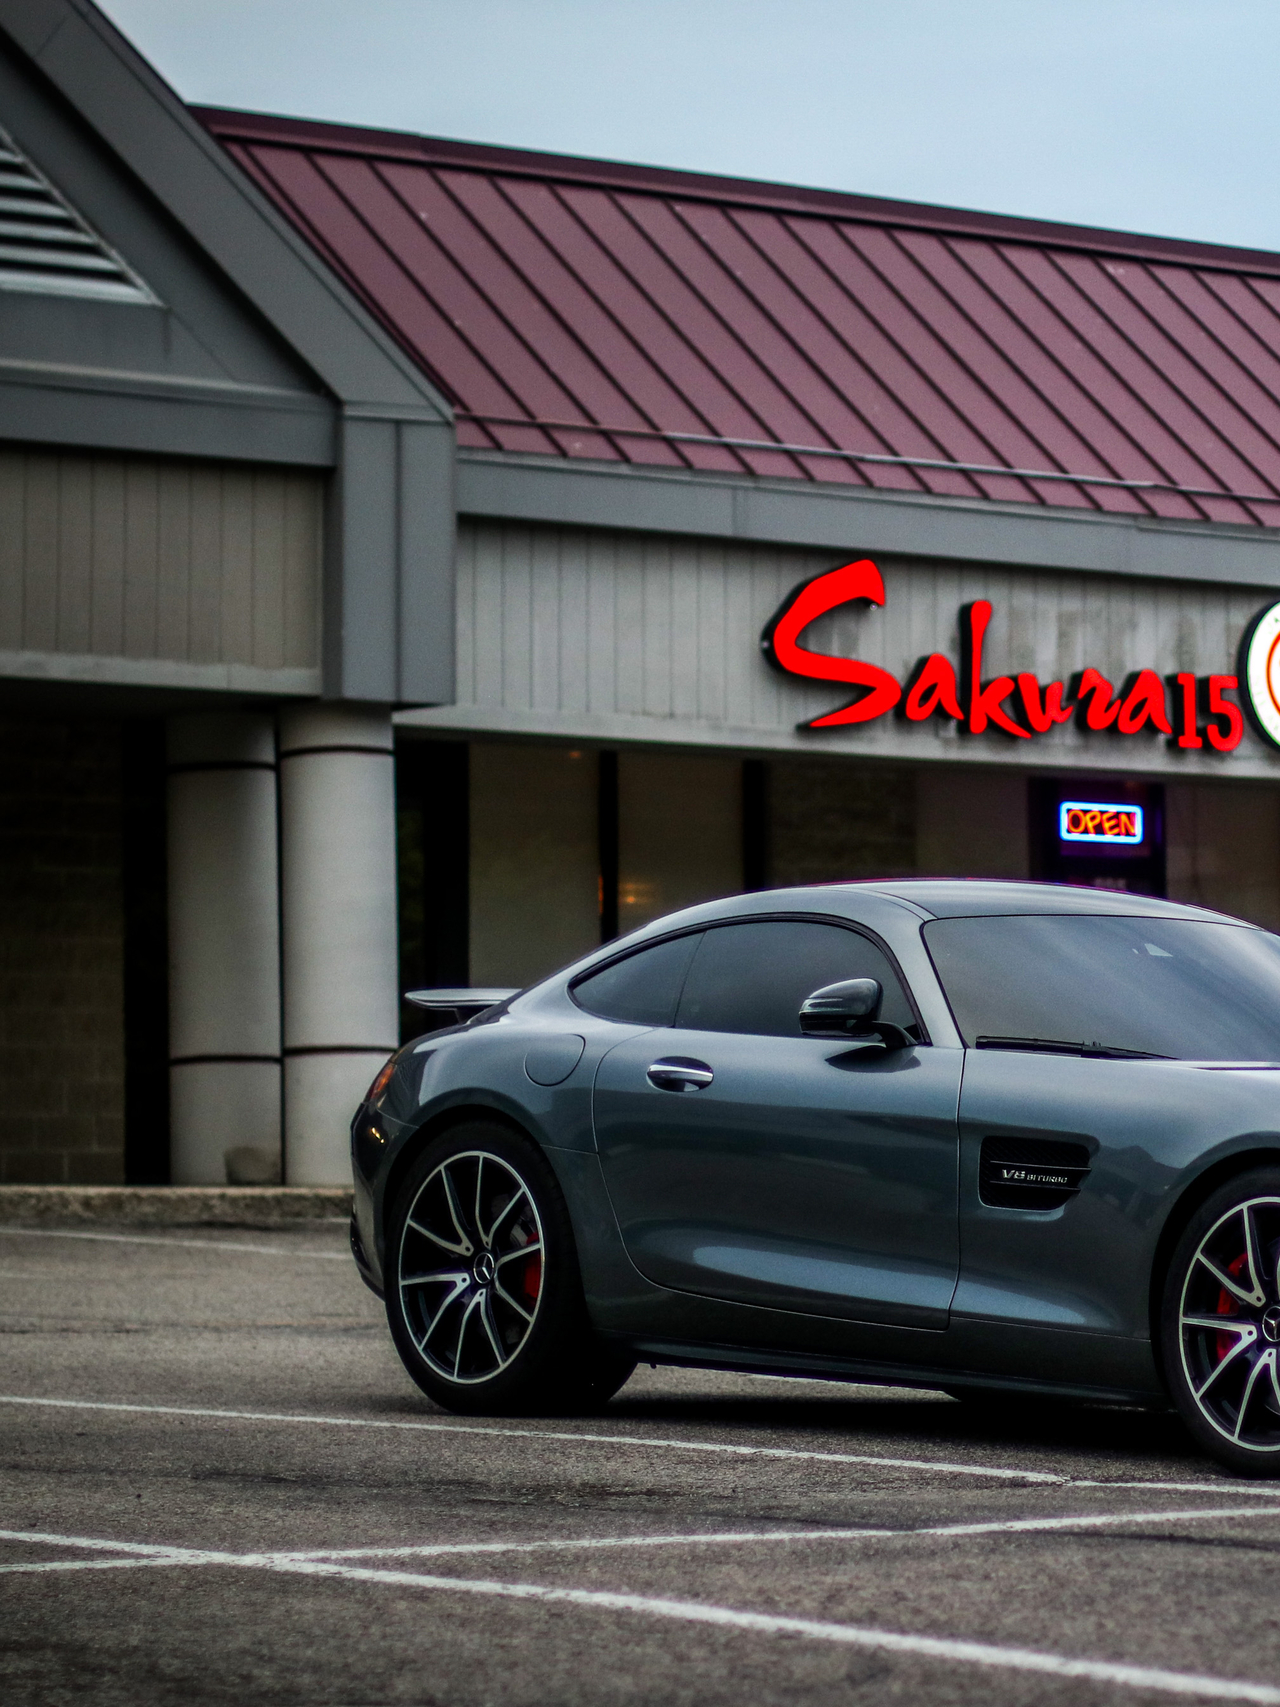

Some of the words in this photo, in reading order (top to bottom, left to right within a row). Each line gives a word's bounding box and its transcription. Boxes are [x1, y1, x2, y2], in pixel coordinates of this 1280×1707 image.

[773, 559, 1172, 738] Sakura
[1067, 809, 1136, 835] OPEN
[1003, 1169, 1025, 1179] V8
[1026, 1174, 1068, 1183] BITURBO
